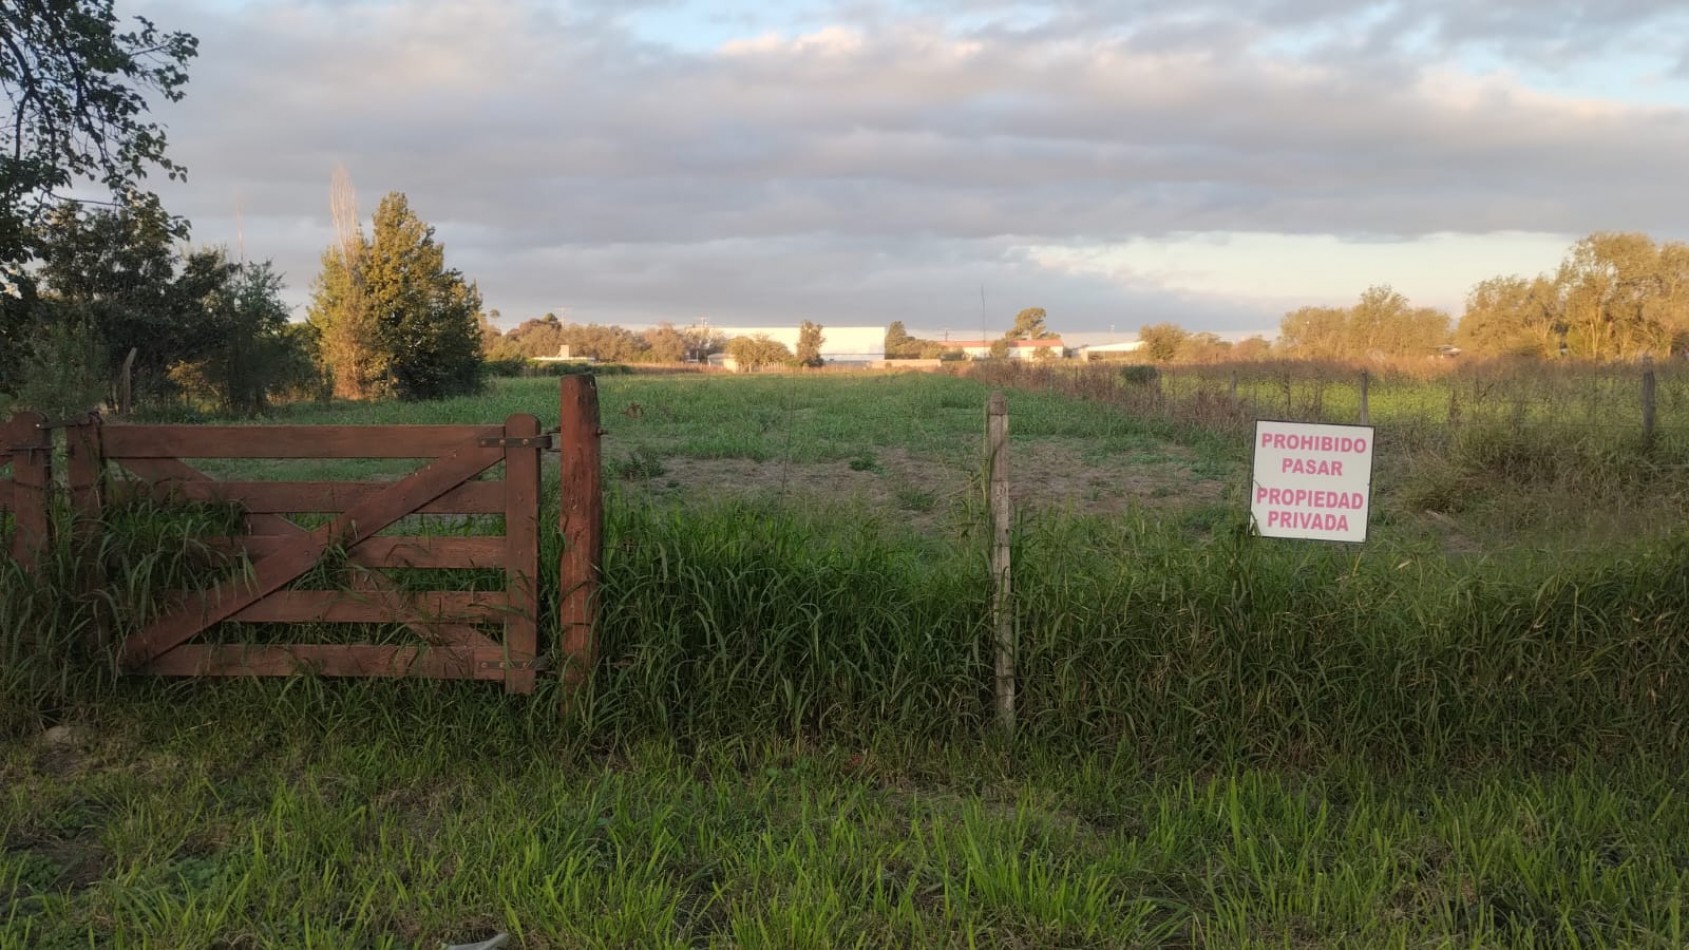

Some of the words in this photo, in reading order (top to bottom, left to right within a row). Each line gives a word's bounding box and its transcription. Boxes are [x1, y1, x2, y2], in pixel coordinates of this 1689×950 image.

[1261, 433, 1367, 453] PROHIBIDO
[1282, 458, 1343, 476] PASAR
[1256, 487, 1364, 510] PROPIEDAD
[1267, 511, 1349, 531] PRIVADA
